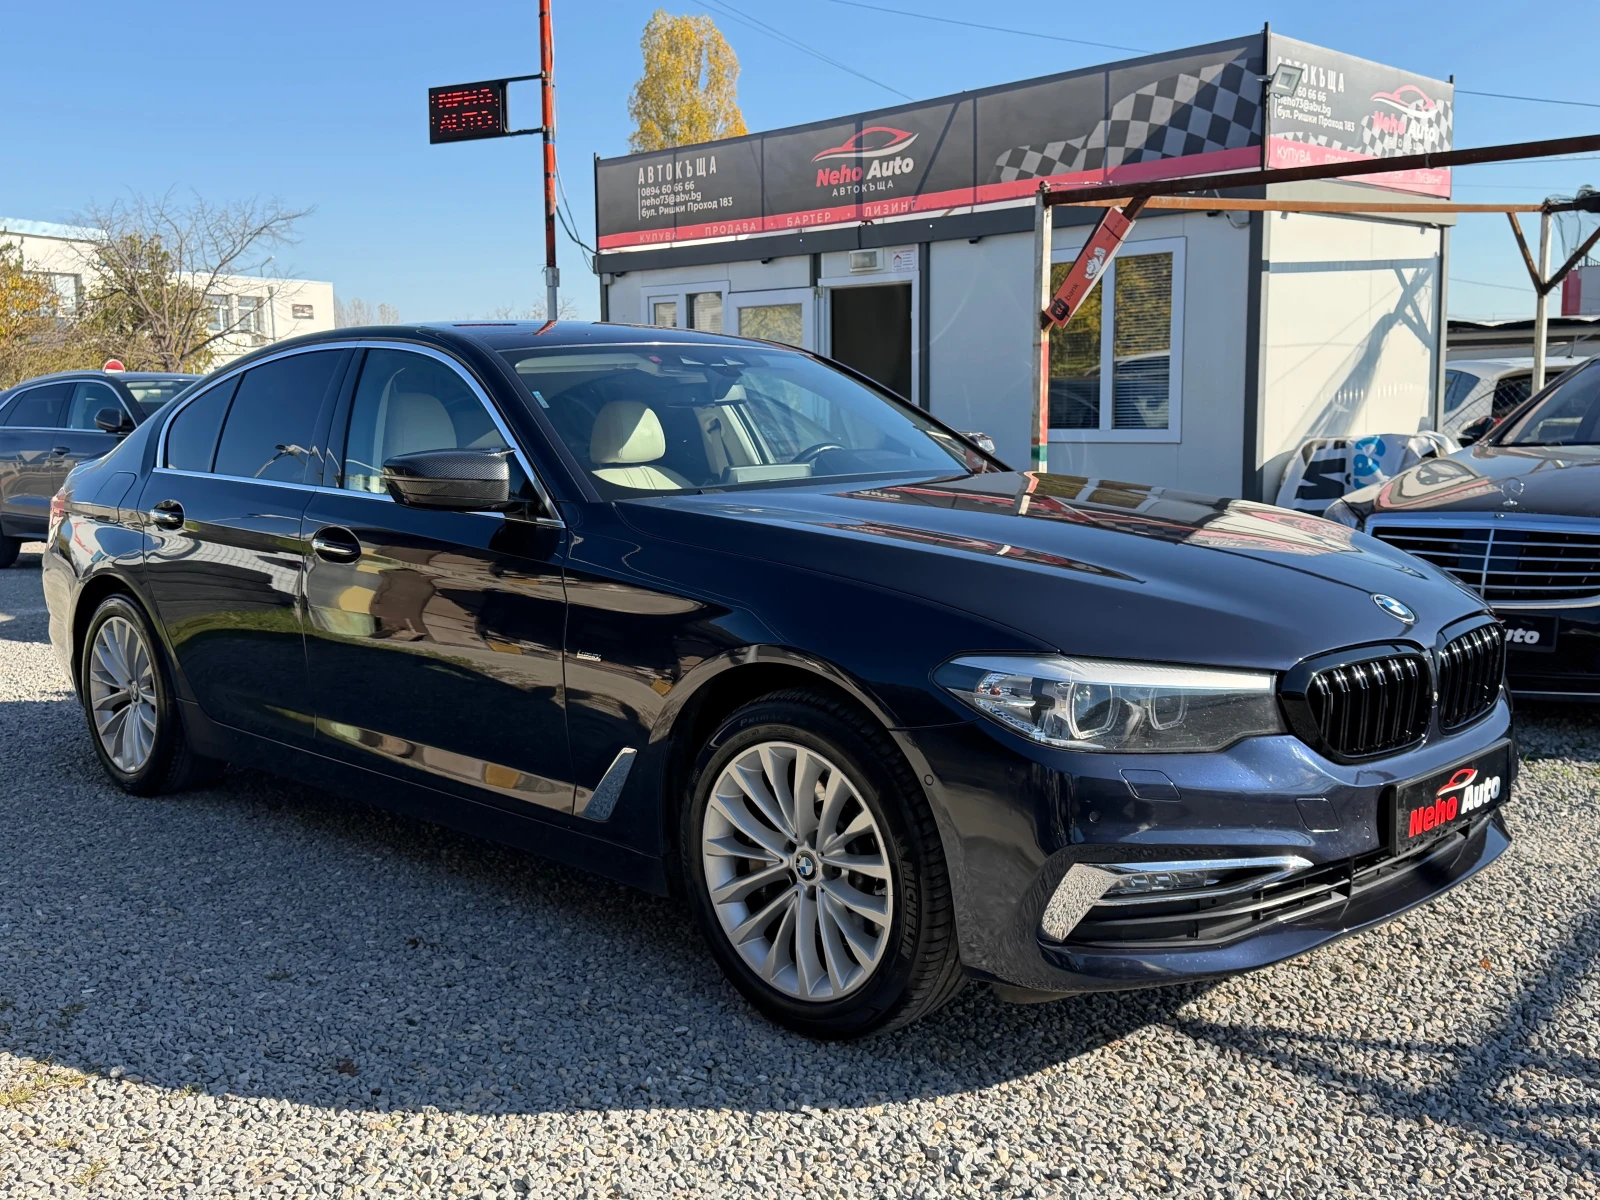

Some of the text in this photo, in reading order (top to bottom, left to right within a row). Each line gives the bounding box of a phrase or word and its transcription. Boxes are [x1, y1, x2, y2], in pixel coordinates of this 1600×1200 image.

[1373, 110, 1436, 142] Neho Auto
[638, 155, 717, 185] АВТОКЪЩА
[816, 156, 914, 187] Neho Auto
[641, 180, 695, 197] 0894 60 66 66
[641, 191, 702, 207] neho73@abv.bg
[832, 179, 894, 197] АВТОКЪЩА
[640, 199, 917, 243] КУПУВА ПРОДАВА БАРТЕР ЛИЗИНГ
[641, 196, 733, 219] бул. Ришки Проход 183
[1408, 775, 1501, 838] Neho Auto
[901, 860, 918, 960] MICHELIN
